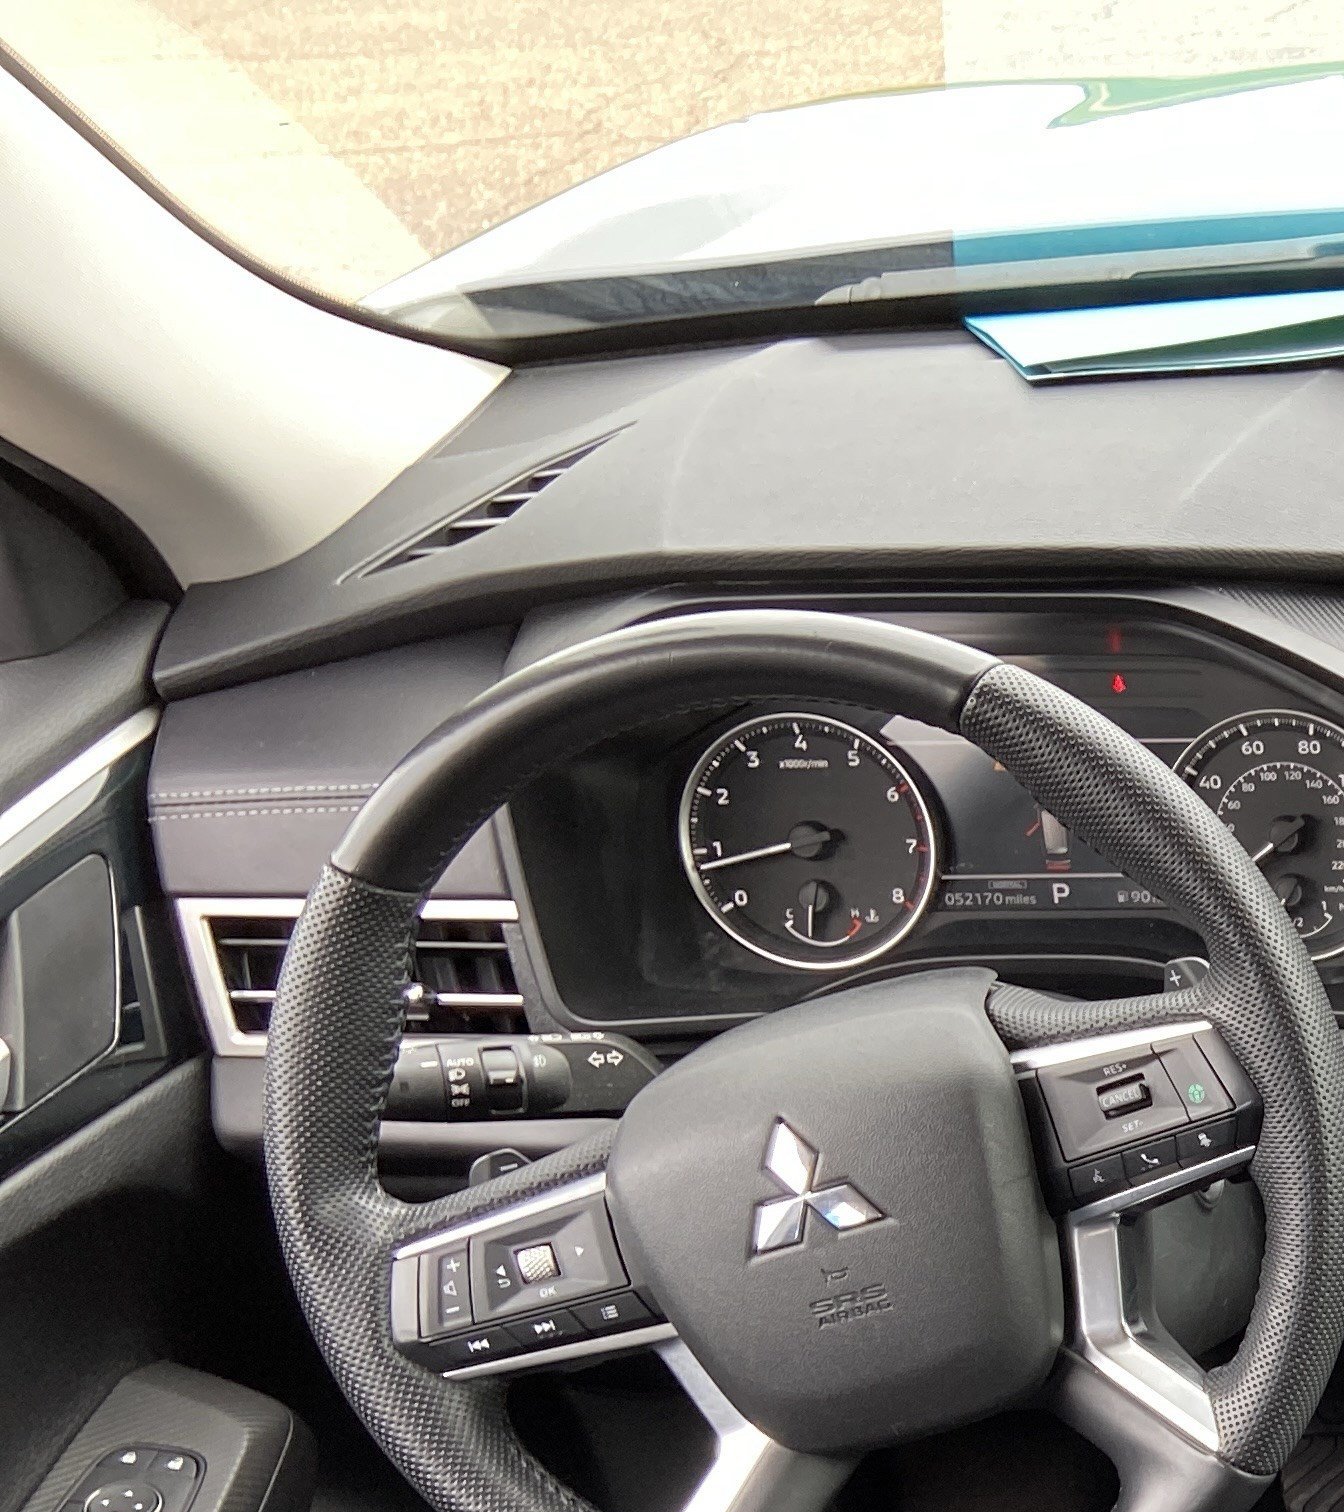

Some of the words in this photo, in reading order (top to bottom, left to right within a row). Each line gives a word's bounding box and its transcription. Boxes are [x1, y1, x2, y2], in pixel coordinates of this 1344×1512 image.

[794, 734, 807, 751] 4
[1241, 740, 1265, 755] 60
[1297, 740, 1321, 755] 80
[747, 751, 760, 768] 3
[847, 750, 861, 767] 5
[1199, 774, 1222, 790] 40
[1259, 771, 1278, 782] 100
[1284, 770, 1302, 781] 120
[1241, 782, 1256, 792] 80
[1305, 779, 1323, 789] 140
[716, 788, 730, 805] 2
[886, 786, 899, 802] 6
[1322, 794, 1340, 805] 160
[1227, 800, 1241, 810] 60
[712, 841, 722, 857] 1
[905, 838, 917, 854] 7
[734, 890, 748, 906] 0
[892, 887, 905, 904] 8
[944, 892, 1003, 906] 052170
[1005, 892, 1037, 905] miles
[1052, 882, 1071, 904] P
[1131, 890, 1151, 903] 90
[446, 1057, 475, 1067] AUTO
[1102, 1087, 1140, 1108] CANCEL
[539, 1286, 558, 1298] OK
[809, 1283, 887, 1318] SRS
[818, 1299, 895, 1331] AIRBAG
